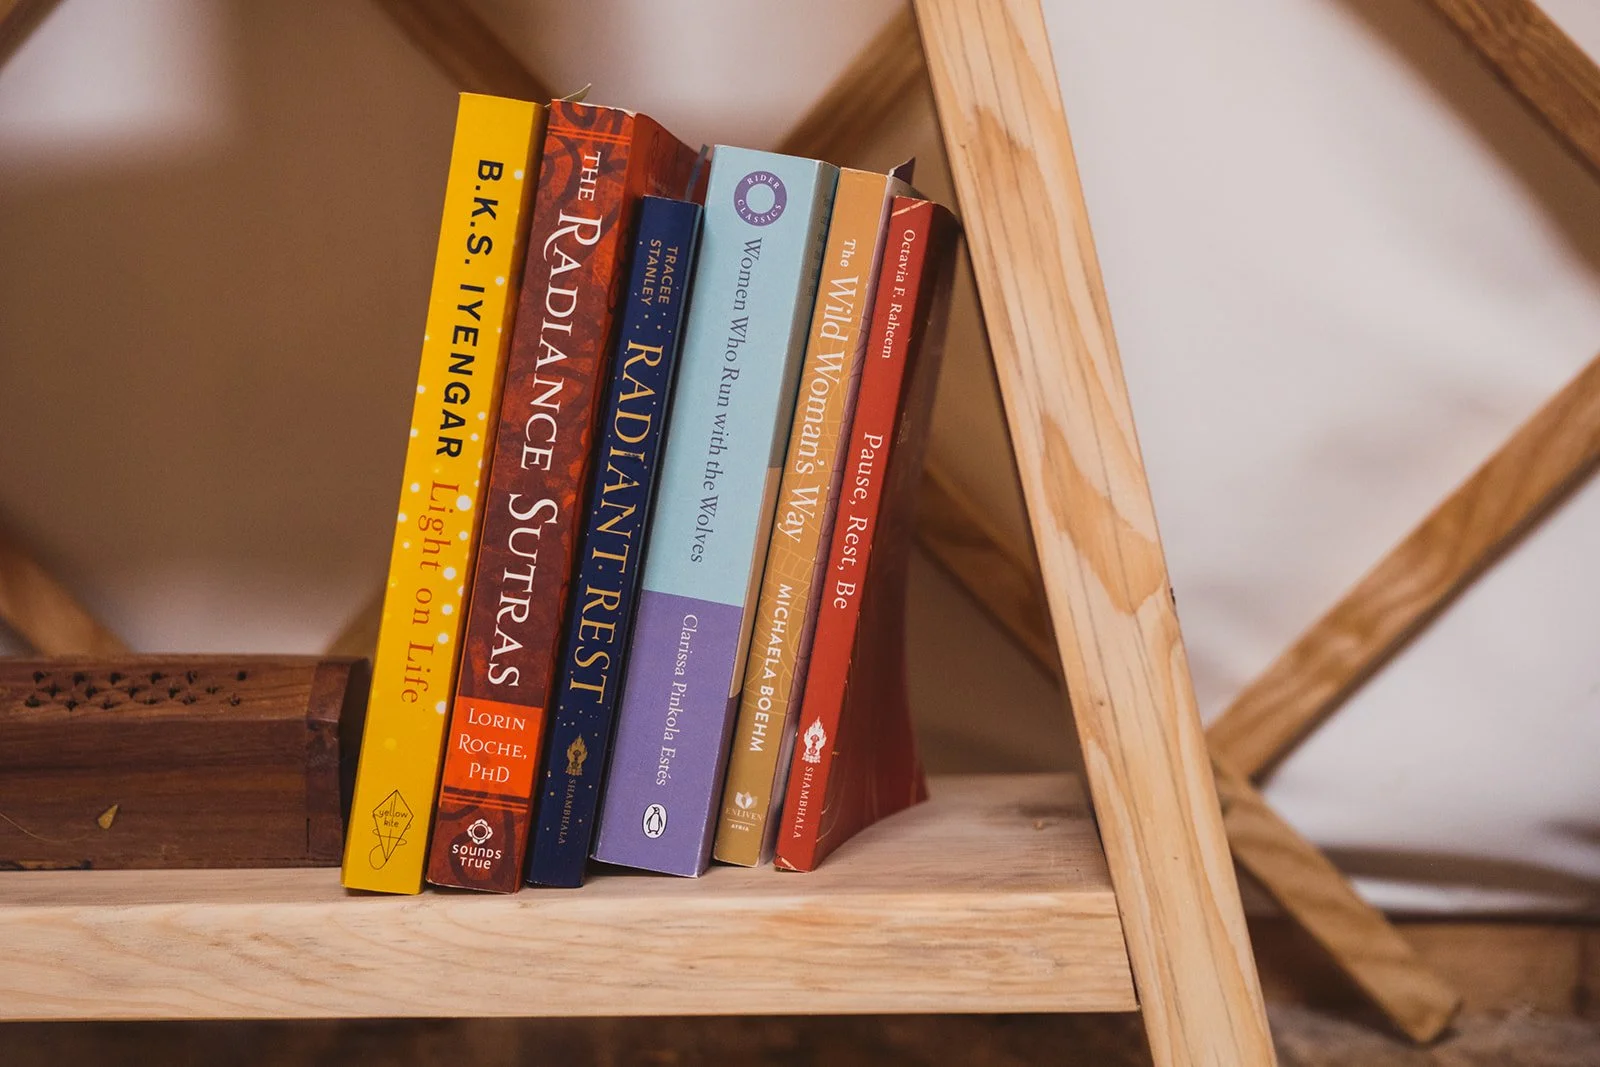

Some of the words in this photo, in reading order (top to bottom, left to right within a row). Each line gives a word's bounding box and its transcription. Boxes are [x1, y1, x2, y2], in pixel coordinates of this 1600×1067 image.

[577, 151, 601, 202] THE
[746, 174, 780, 189] RIDER
[464, 159, 504, 264] B.K.S.
[737, 199, 782, 223] CLASSICS
[643, 238, 662, 306] STANLEY
[658, 246, 678, 304] TRACEE
[733, 237, 762, 311] Women
[840, 239, 857, 268] The
[895, 229, 916, 283] Octavia
[820, 275, 859, 342] Wild
[892, 286, 905, 299] F.
[520, 209, 602, 471] RADIANCE
[724, 316, 749, 362] Who
[881, 302, 903, 359] Raheem
[435, 283, 485, 458] IYENGAR
[717, 367, 740, 407] Run
[708, 413, 730, 456] with
[795, 350, 845, 475] Woman's
[592, 340, 663, 573] RADIANT
[703, 460, 724, 491] the
[848, 431, 884, 506] Pause,
[418, 480, 460, 570] Light
[690, 494, 720, 564] Wolves
[777, 484, 819, 543] Way
[837, 514, 868, 571] Rest,
[411, 588, 433, 626] on
[486, 493, 558, 687] SUTRAS
[833, 580, 856, 609] Be
[569, 584, 622, 704] REST
[673, 614, 698, 676] Clarissa
[762, 583, 792, 679] MICHAELA
[401, 641, 434, 704] Life
[468, 708, 526, 731] LORIN
[663, 681, 688, 741] Pinkola
[749, 685, 775, 752] BOEHM
[458, 733, 527, 760] ROCHE,
[656, 746, 676, 786] Estés
[378, 801, 408, 818] yellow
[384, 816, 400, 828] kite
[558, 778, 577, 845] SHAMBHALA
[792, 766, 814, 839] SHAMBHALA
